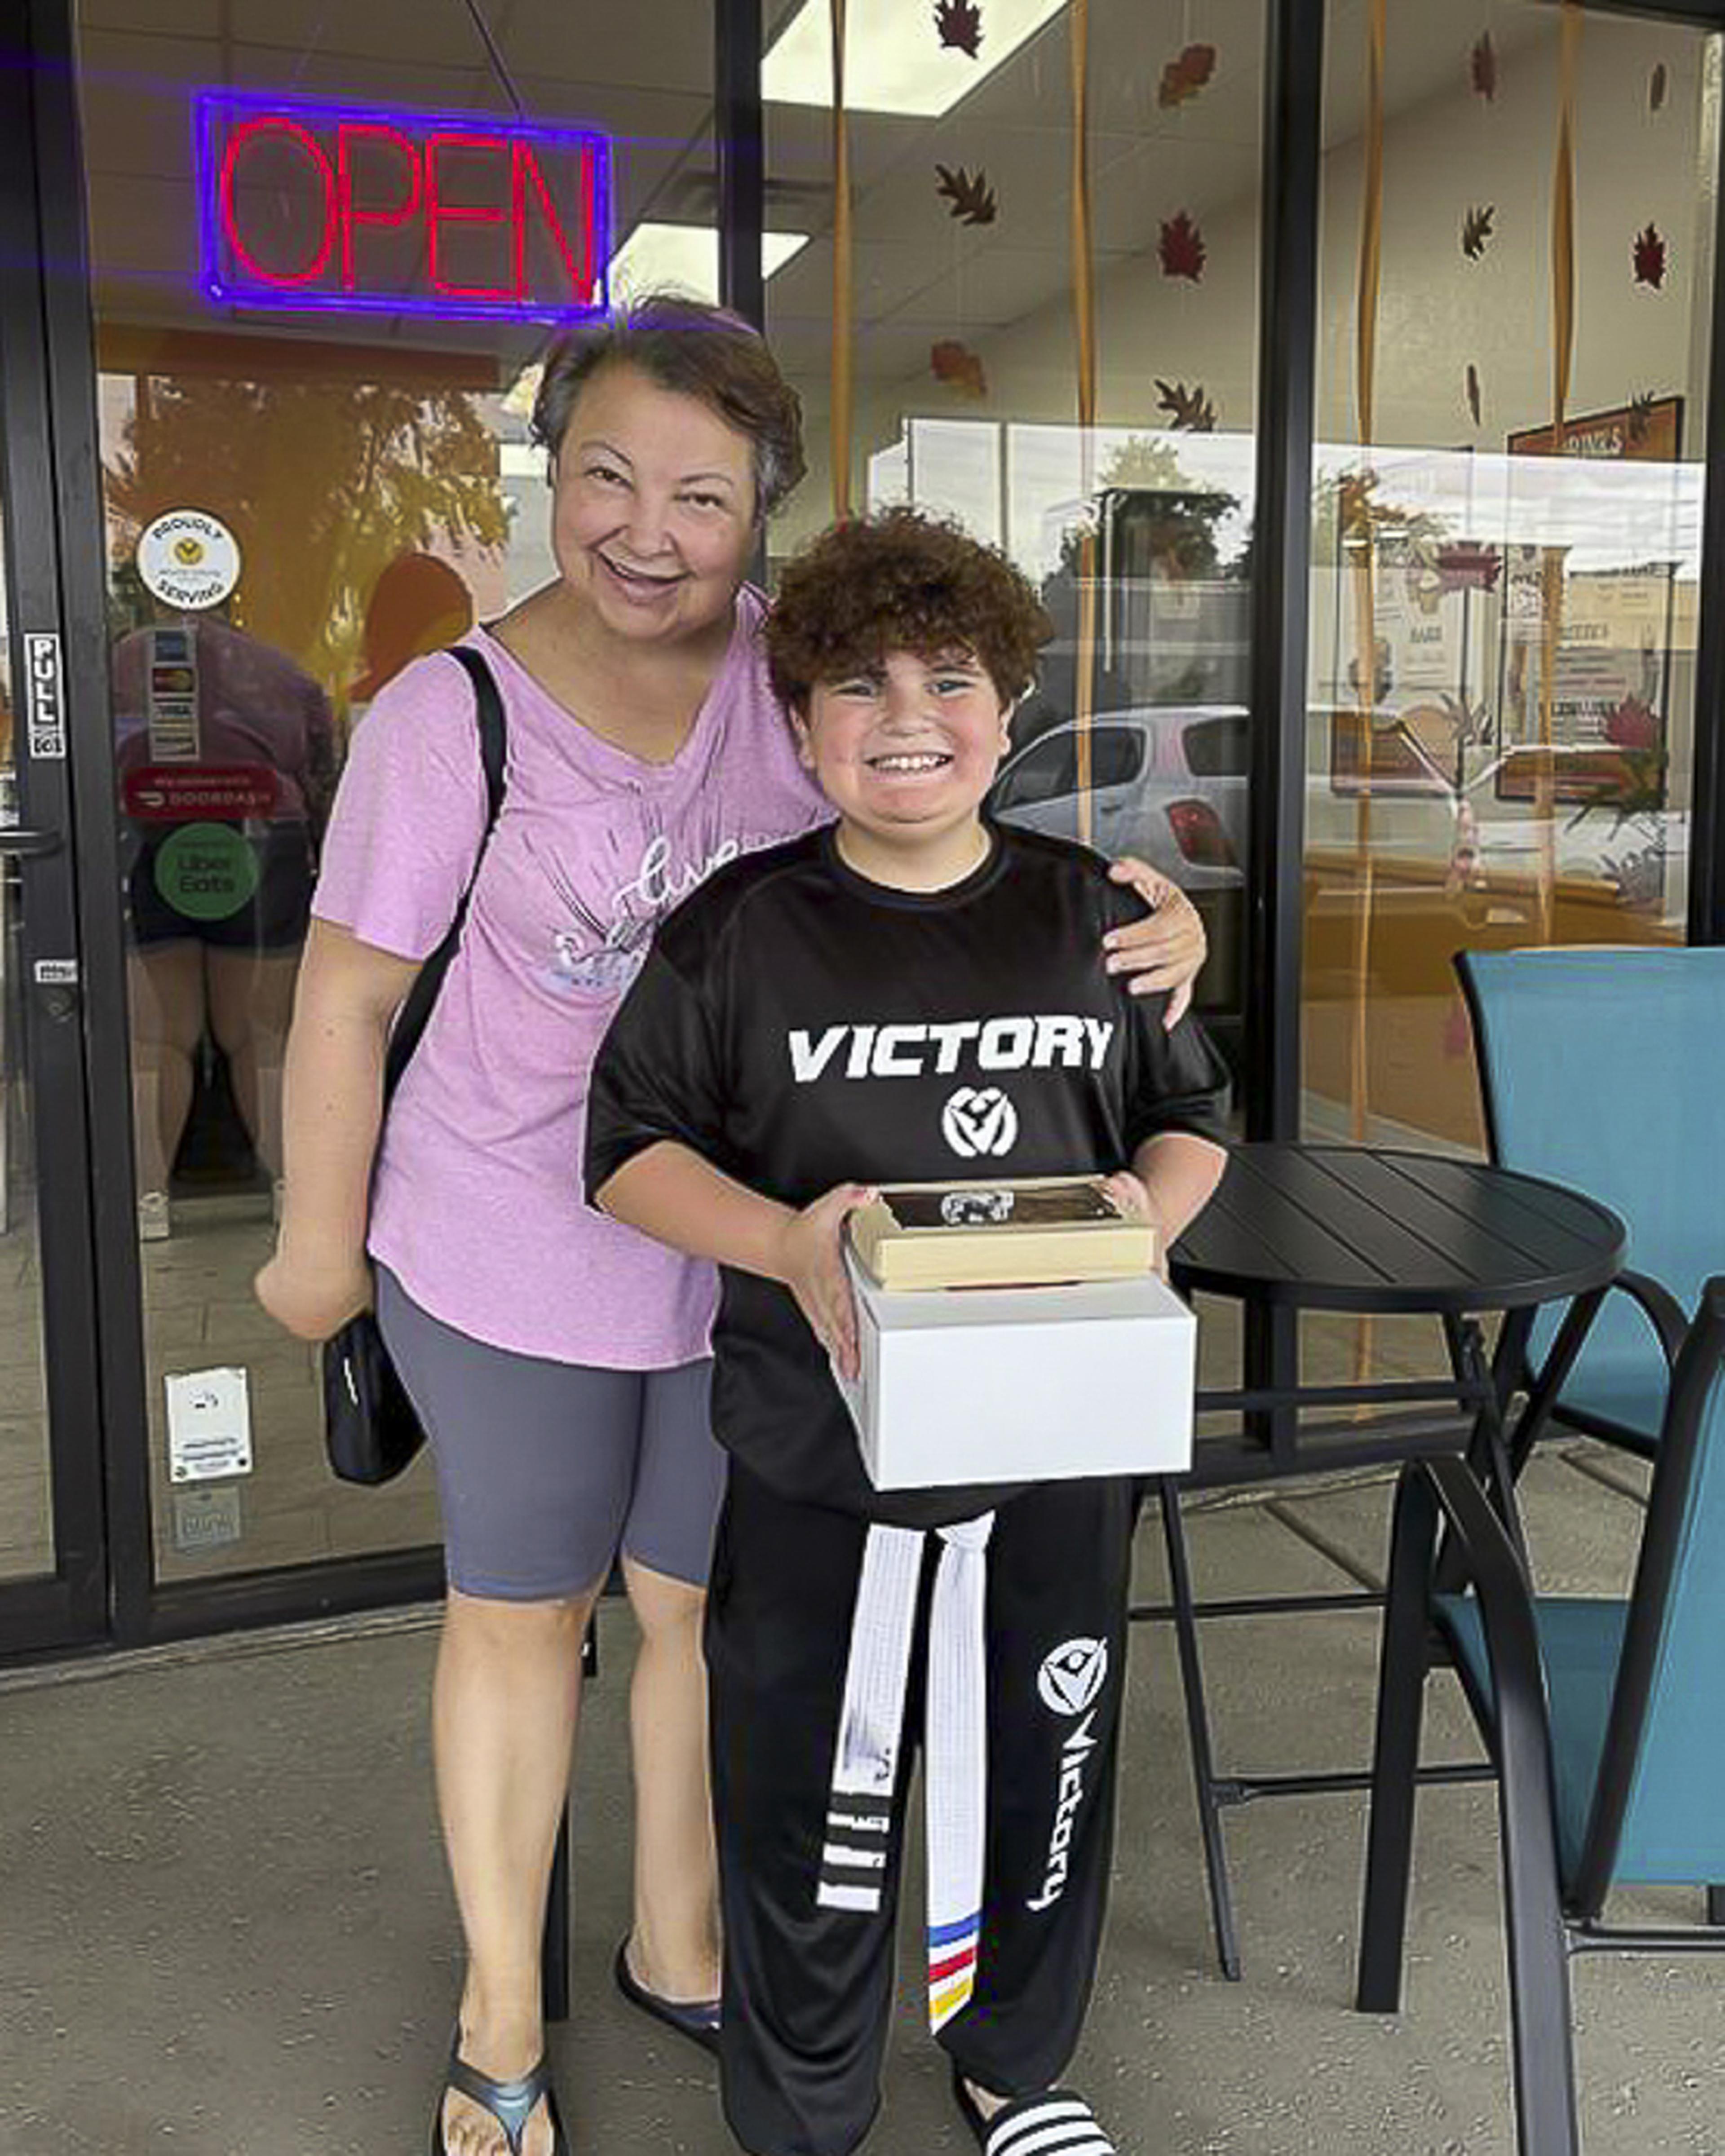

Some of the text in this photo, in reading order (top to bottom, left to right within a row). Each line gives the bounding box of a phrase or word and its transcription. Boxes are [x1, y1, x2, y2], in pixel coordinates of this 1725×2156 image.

[219, 117, 593, 307] OPEN
[34, 639, 55, 722] PULL
[788, 1015, 1113, 1082] VICTORY
